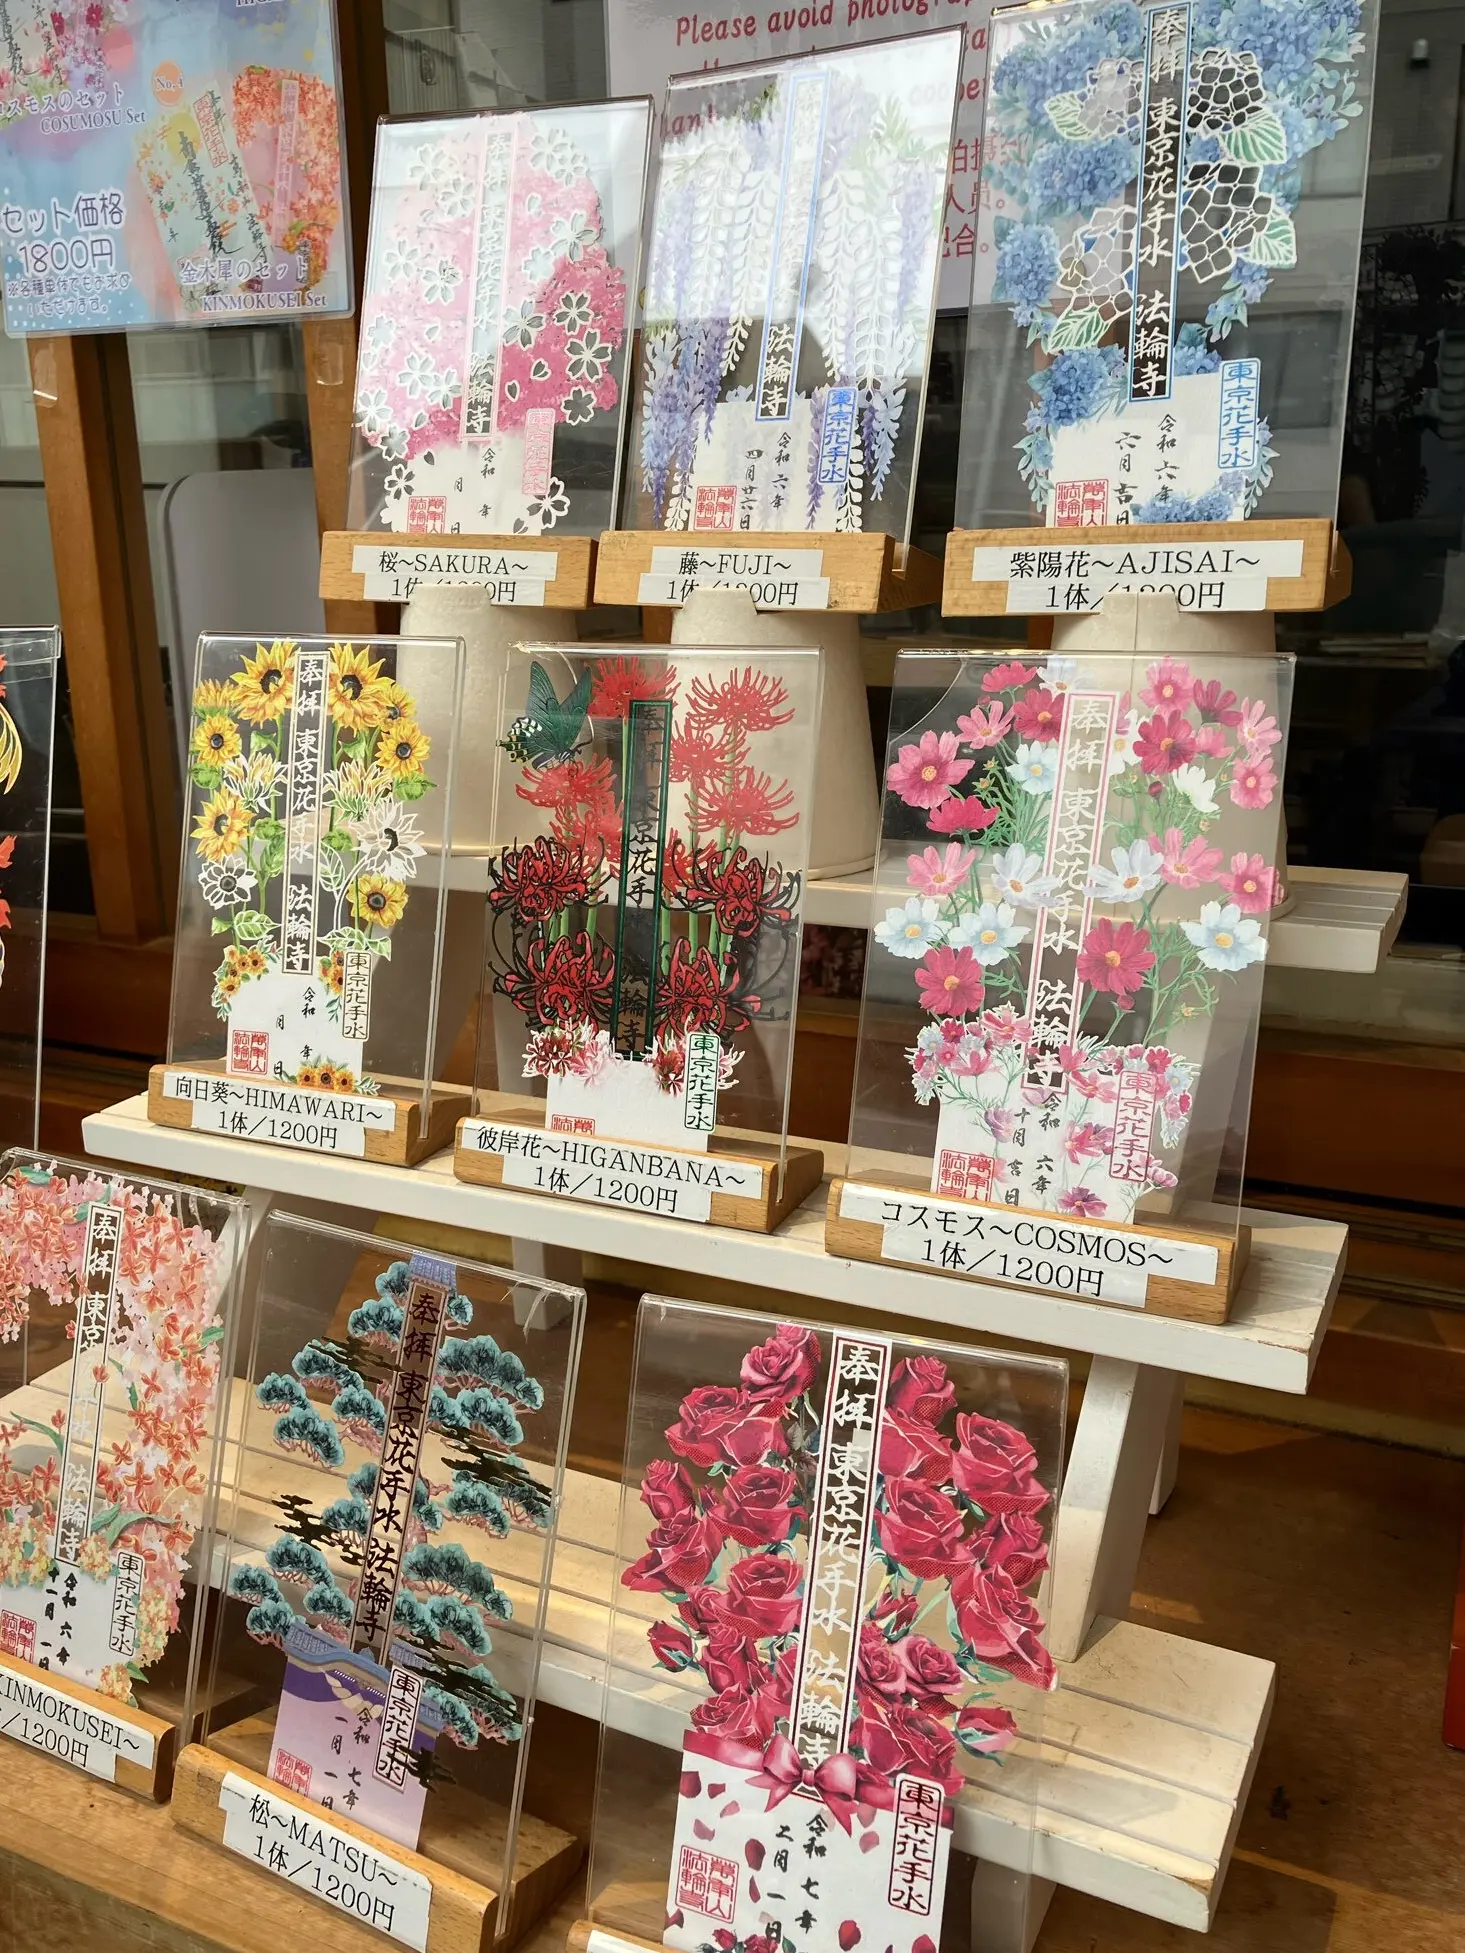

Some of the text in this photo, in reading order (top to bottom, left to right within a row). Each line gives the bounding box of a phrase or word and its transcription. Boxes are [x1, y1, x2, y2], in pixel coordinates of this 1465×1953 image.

[676, 14, 757, 46] Please
[767, 0, 834, 33] avoid
[0, 84, 124, 115] スモスのセット
[41, 107, 146, 133] COSUMOSU Set
[3, 193, 123, 233] セット価格
[1139, 98, 1181, 268] 東京花手水
[20, 238, 113, 273] 1800円
[181, 257, 309, 284] 金木犀のセット
[203, 292, 327, 312] KINMOKUSEI Set
[761, 324, 796, 418] 法輪寺
[1133, 293, 1171, 397] 法輪寺
[467, 352, 496, 433] 法輪寺
[1220, 361, 1257, 467] 東京花手水
[480, 448, 496, 478] 令和
[821, 389, 853, 482] 東京花手水
[391, 577, 517, 603] 1体0円
[666, 579, 799, 606] 1体00円
[1045, 581, 1226, 611] 1体／0円
[285, 659, 323, 972] 奉拝 東京花手水 法輪寺
[1030, 700, 1108, 1088] 奉拝 東京花手水 法輪寺
[300, 986, 316, 1059] 令和 年
[344, 953, 369, 1039] 東京花手水
[274, 1014, 284, 1076] 月 日
[687, 1036, 718, 1131] 東京花手水
[218, 1110, 337, 1149] 1体／1200円
[1112, 1073, 1154, 1180] 東京花手水
[533, 1166, 678, 1213] 1体／1200円
[89, 1214, 116, 1280] 奉拝
[920, 1239, 1105, 1297] 1体／1200円
[833, 1346, 879, 1428] 奉拝
[355, 1292, 440, 1642] 奉拝 東京花手水 法輪寺
[812, 1442, 869, 1634] 東京花手水
[111, 1555, 142, 1654] 東京花手水
[0, 1672, 140, 1750] INMOKUSEI～
[0, 1707, 89, 1768] ／1200円
[253, 1835, 396, 1932] 1体／1200円
[893, 1782, 940, 1911] 東京花手水
